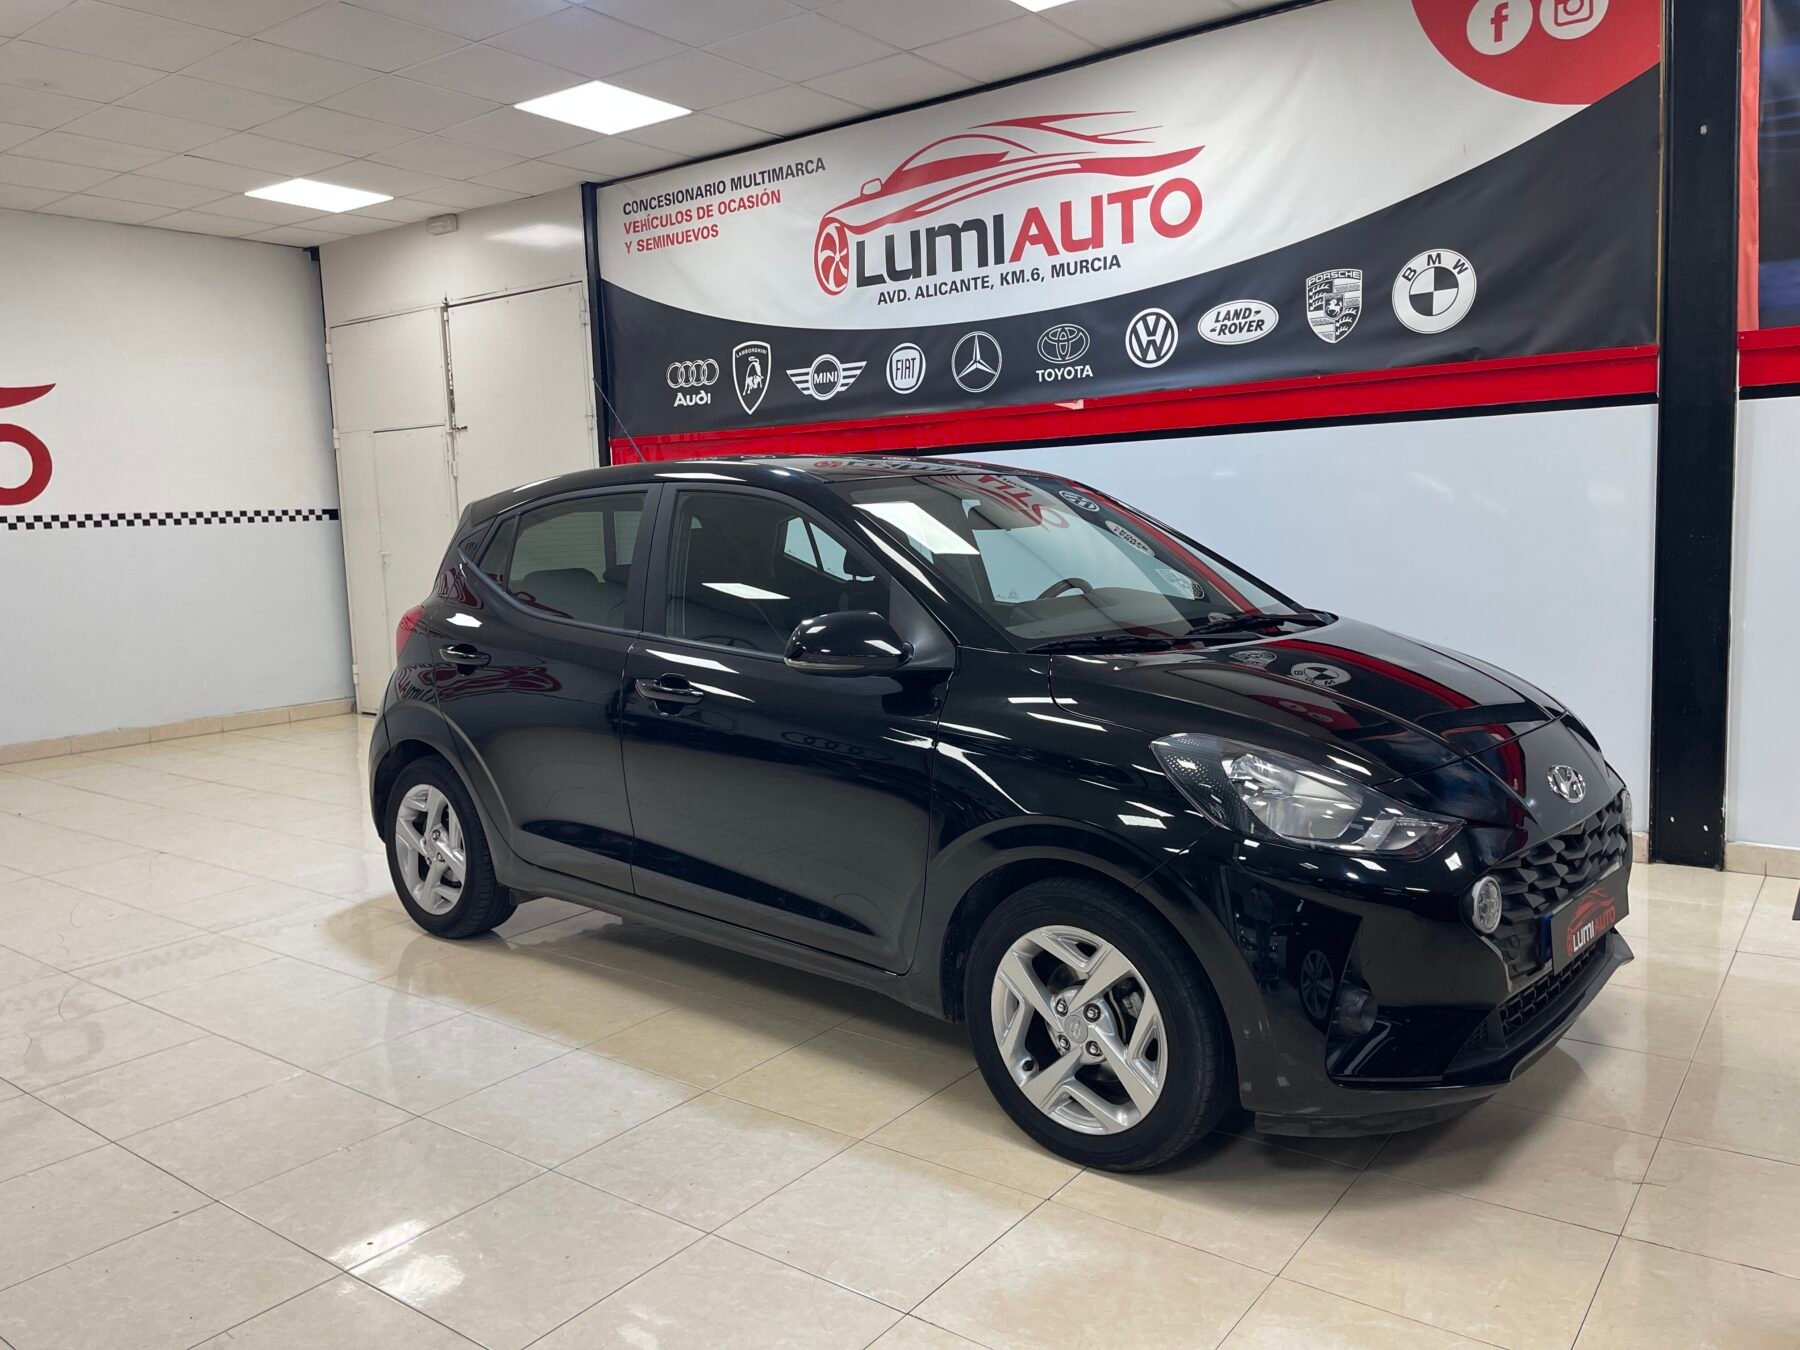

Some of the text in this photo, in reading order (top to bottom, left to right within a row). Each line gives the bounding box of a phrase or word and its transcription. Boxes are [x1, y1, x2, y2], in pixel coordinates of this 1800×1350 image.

[623, 157, 827, 216] CONCESIONARIO MULTIMARCA
[623, 187, 782, 235] VEHÍCULOS DE OCASIÓN
[624, 223, 719, 255] Y SEMINUEVOS
[876, 287, 911, 306] AVD.
[914, 275, 996, 301] ALICANTE,
[1050, 254, 1122, 279] MURCIA
[1307, 269, 1361, 287] PORSCHE
[813, 370, 838, 385] MINI
[894, 356, 917, 381] FIAT
[1035, 364, 1094, 383] TOYOTA
[673, 391, 712, 408] Audi
